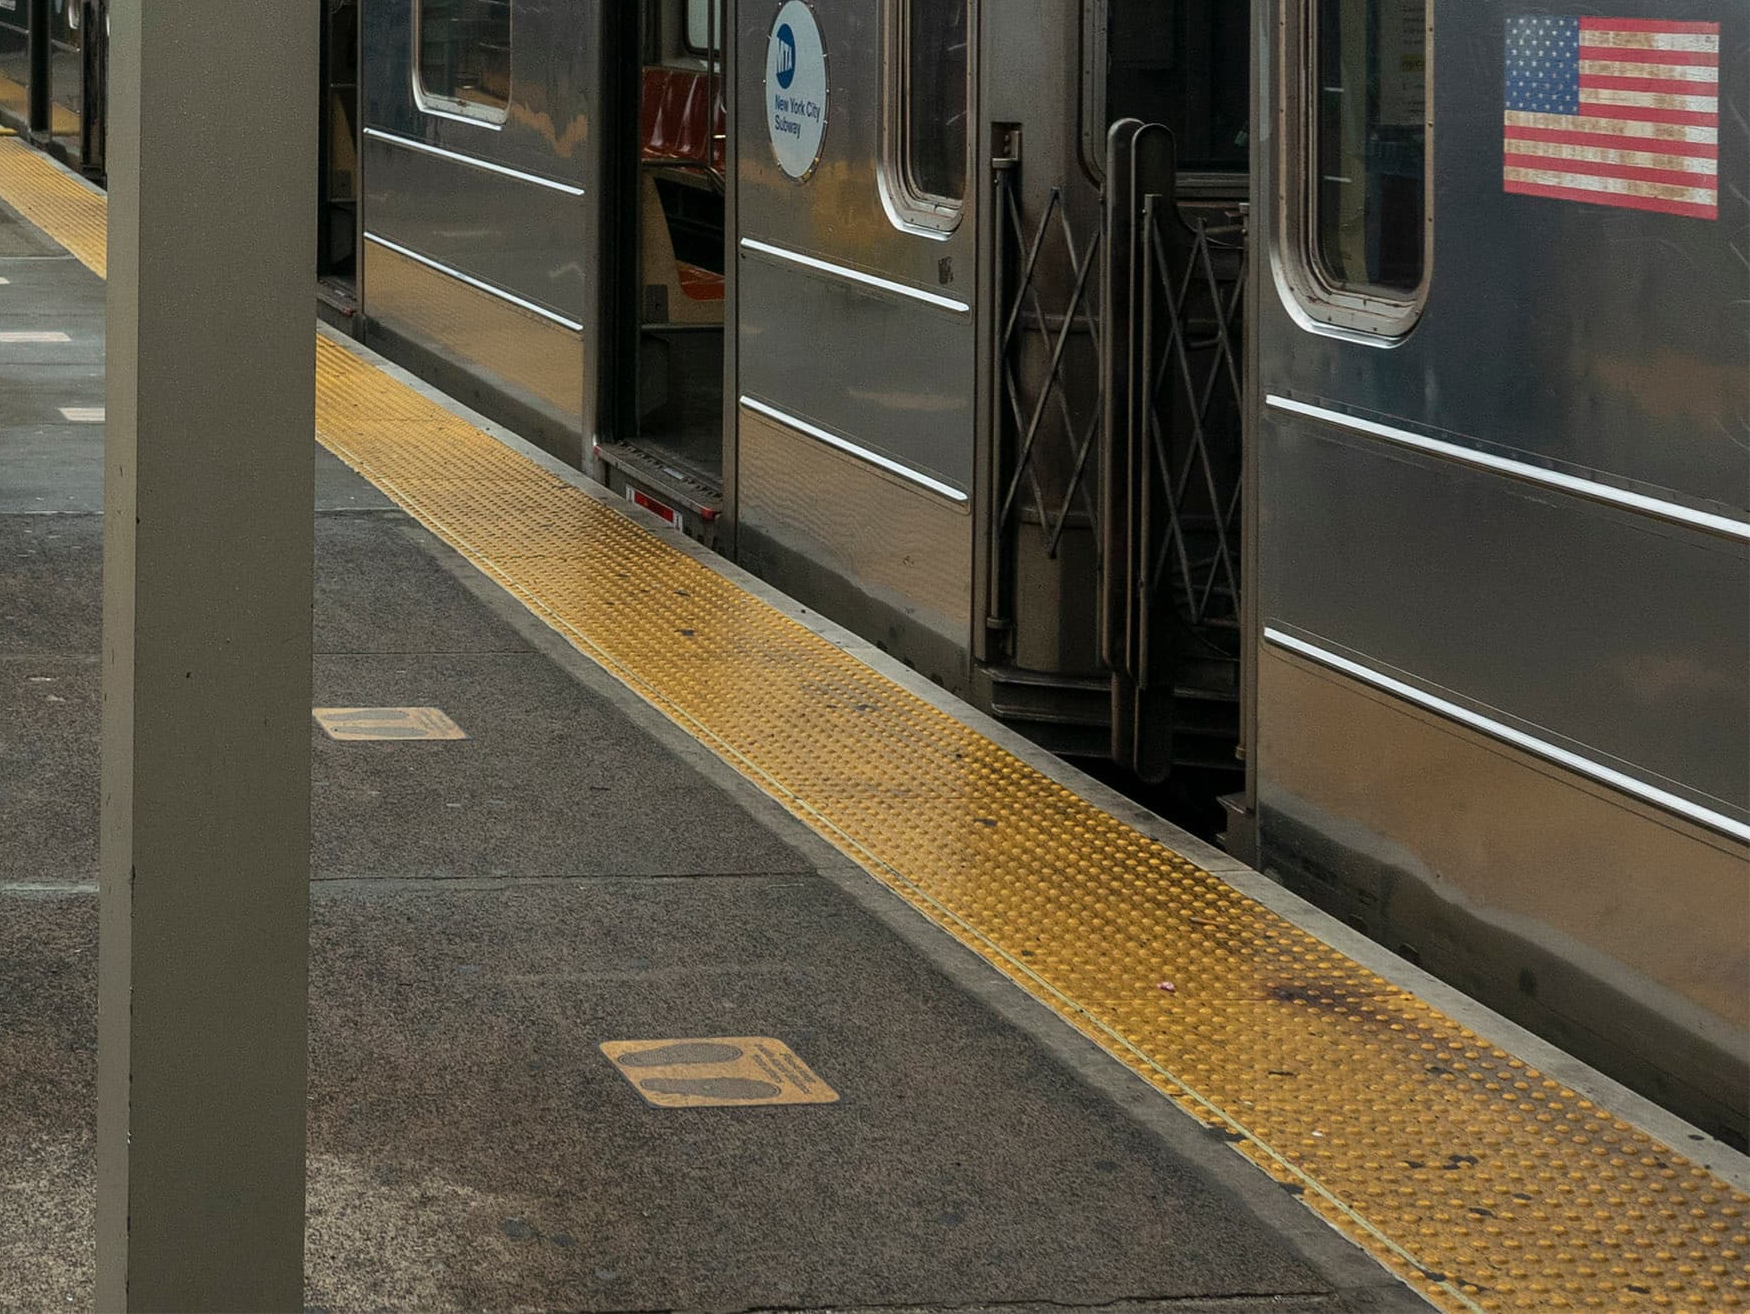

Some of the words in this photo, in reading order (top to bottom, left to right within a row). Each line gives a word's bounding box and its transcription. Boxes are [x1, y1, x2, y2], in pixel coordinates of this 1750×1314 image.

[774, 93, 788, 112] New
[790, 97, 805, 116] York
[806, 101, 821, 123] City
[774, 114, 801, 139] Subway
